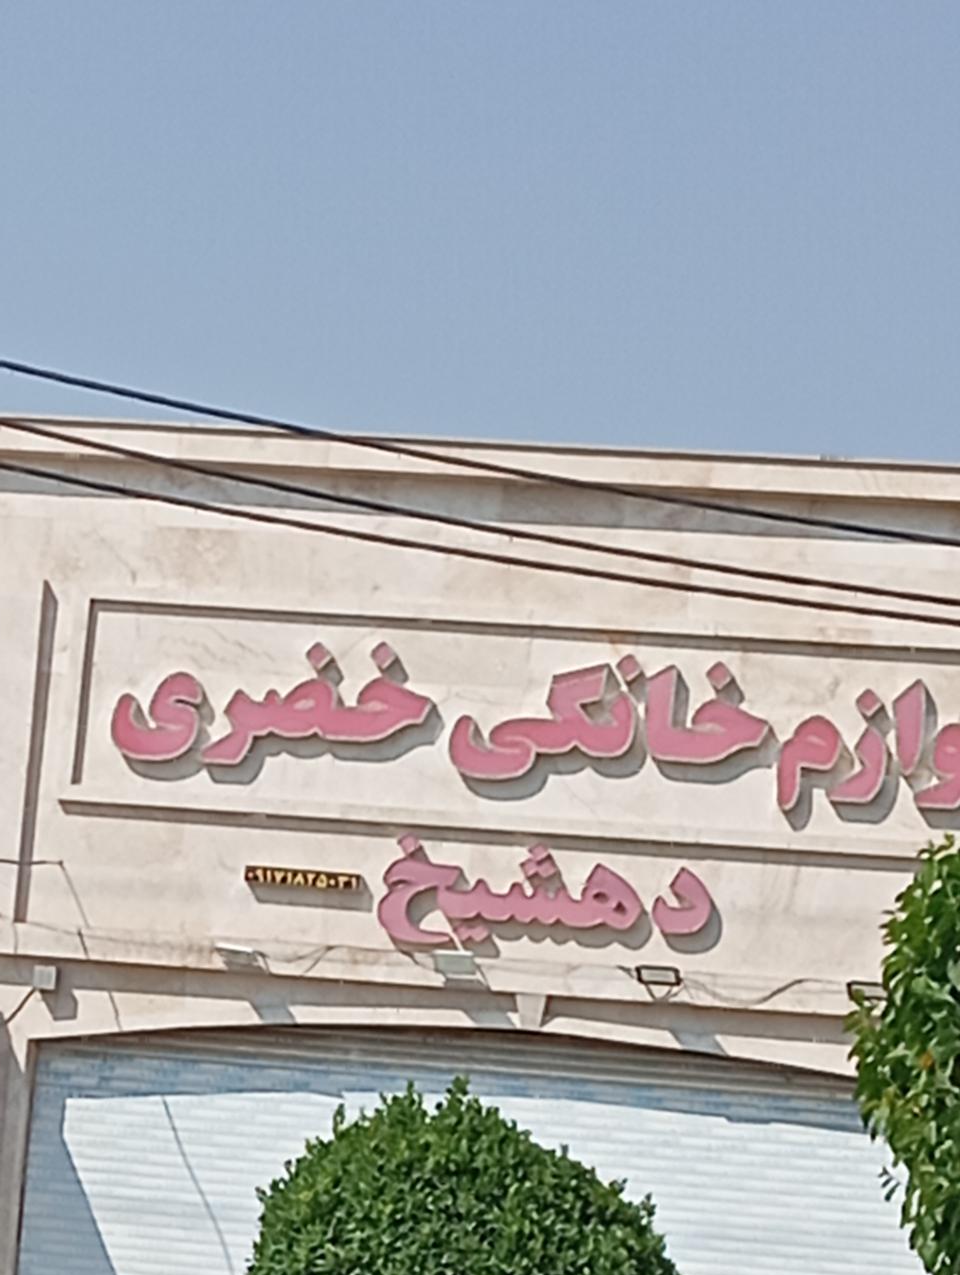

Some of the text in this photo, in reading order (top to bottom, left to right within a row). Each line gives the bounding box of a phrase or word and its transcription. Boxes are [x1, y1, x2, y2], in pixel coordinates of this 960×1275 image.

[110, 641, 960, 812] وازم خانگی خضری
